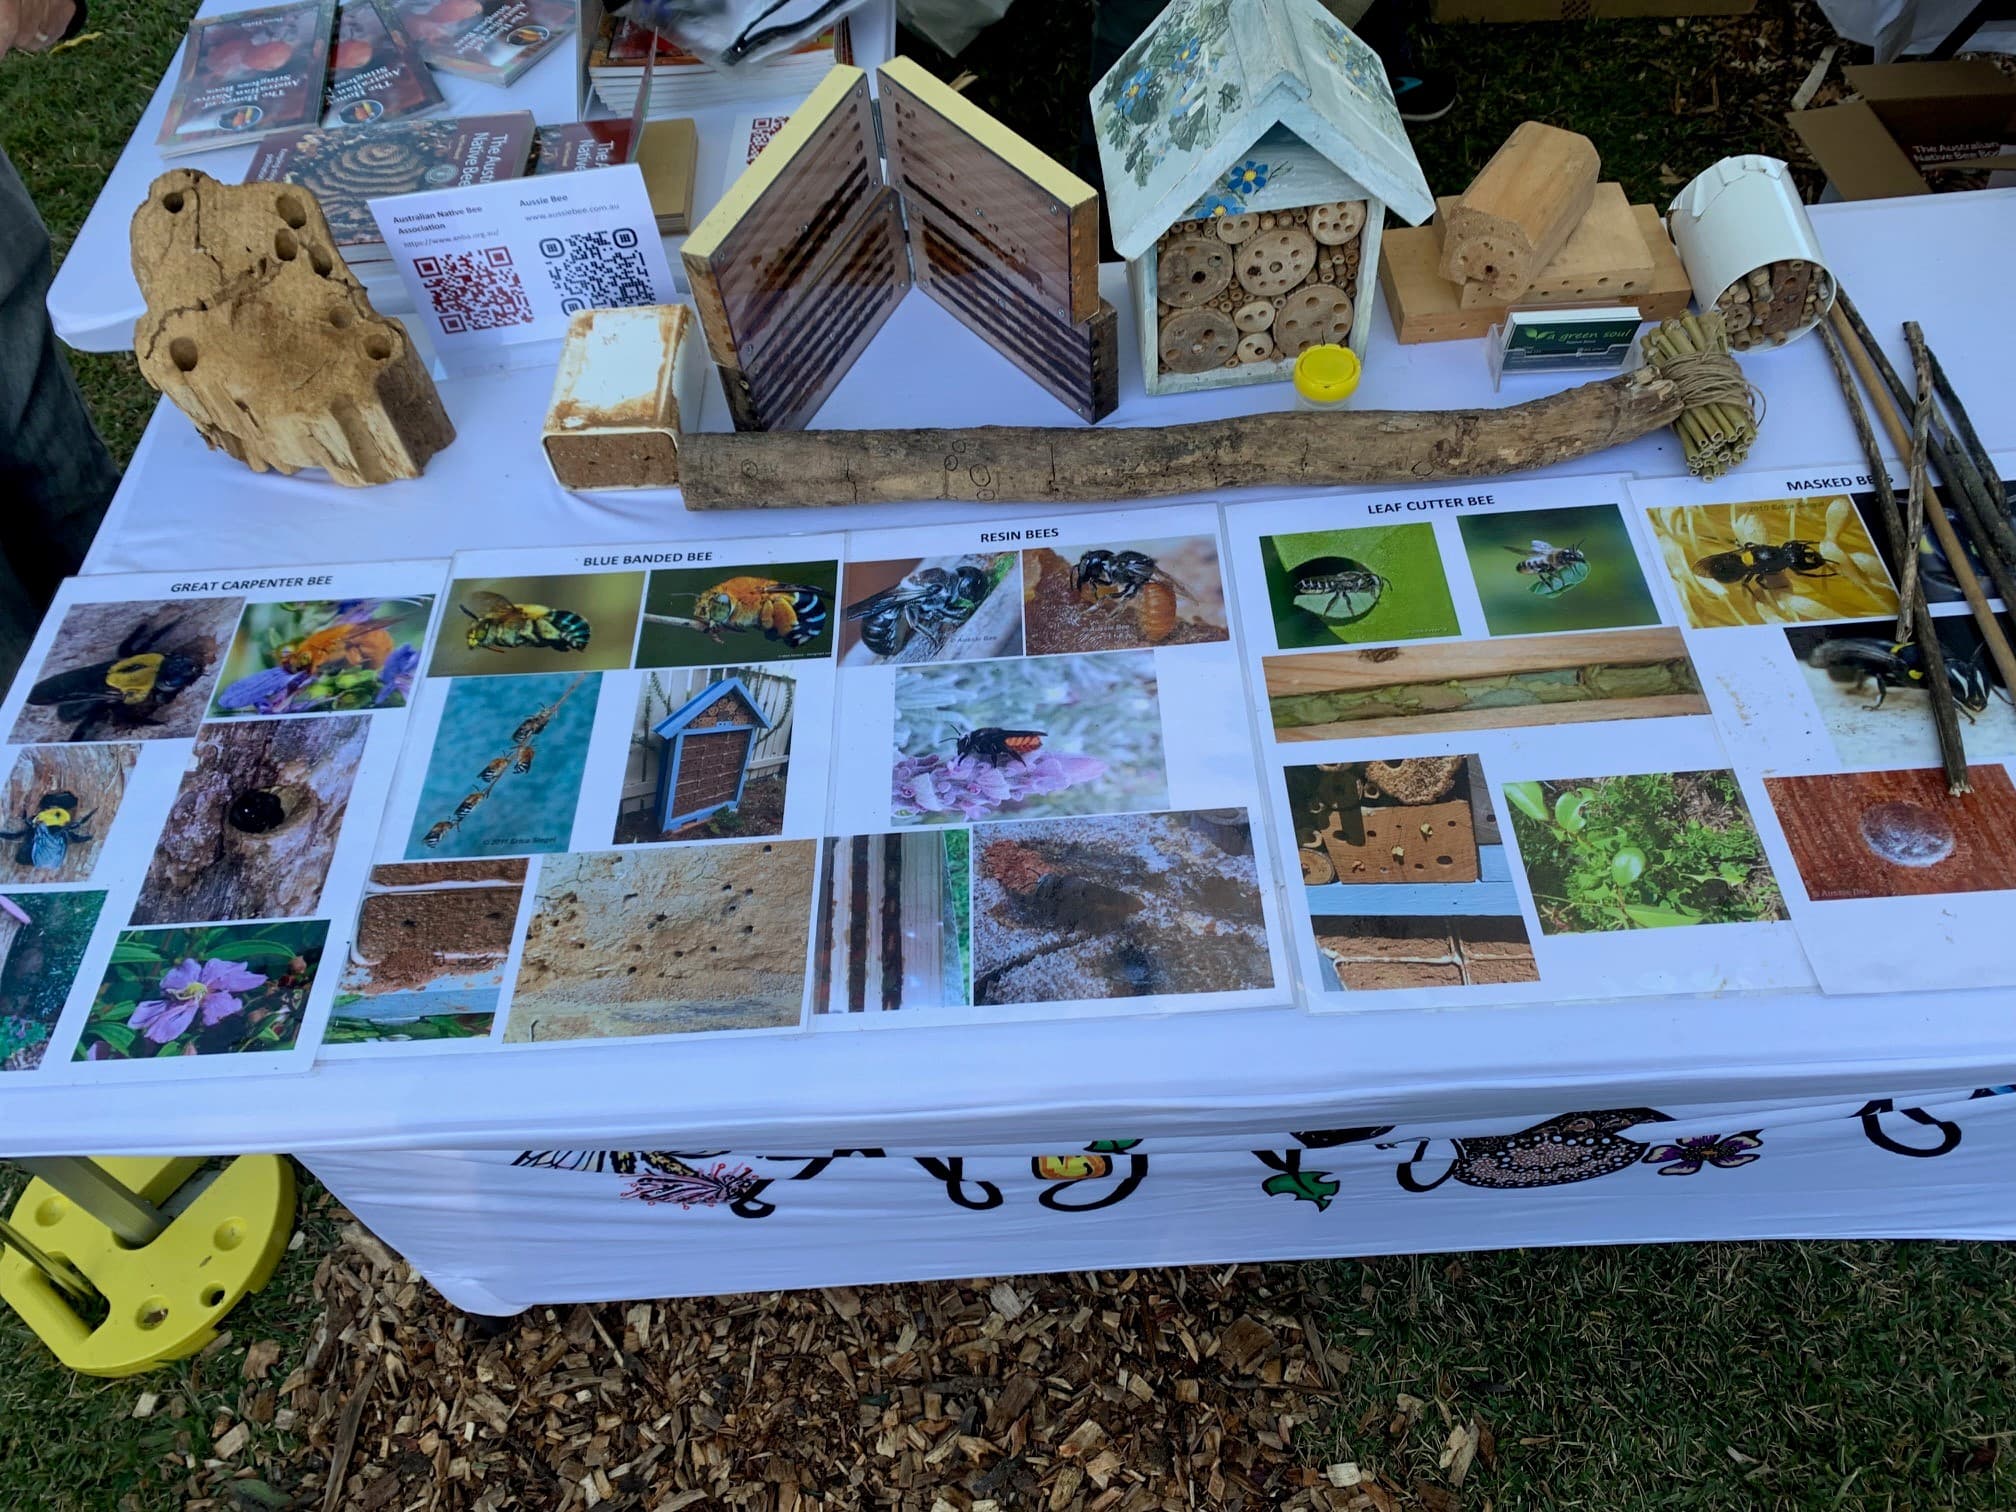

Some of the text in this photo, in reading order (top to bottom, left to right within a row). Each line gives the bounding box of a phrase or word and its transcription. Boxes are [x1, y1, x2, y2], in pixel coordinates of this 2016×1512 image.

[464, 131, 491, 166] Native
[596, 140, 614, 161] The
[480, 133, 508, 185] The Austr
[519, 194, 568, 207] Aussie Bee
[393, 206, 483, 224] Australian Native Bee
[525, 203, 620, 221] www.aussiebee.com.au
[398, 223, 446, 235] Association
[1557, 331, 1599, 342] green
[1603, 328, 1633, 339] soul
[1786, 474, 1894, 491] MASKED BES
[1367, 495, 1496, 514] LEAF CUTTER BEE
[980, 527, 1060, 543] RESIN BEES
[583, 551, 713, 567] BLUE BANDED BEE
[170, 575, 334, 593] GREAT CARPENTER BEE
